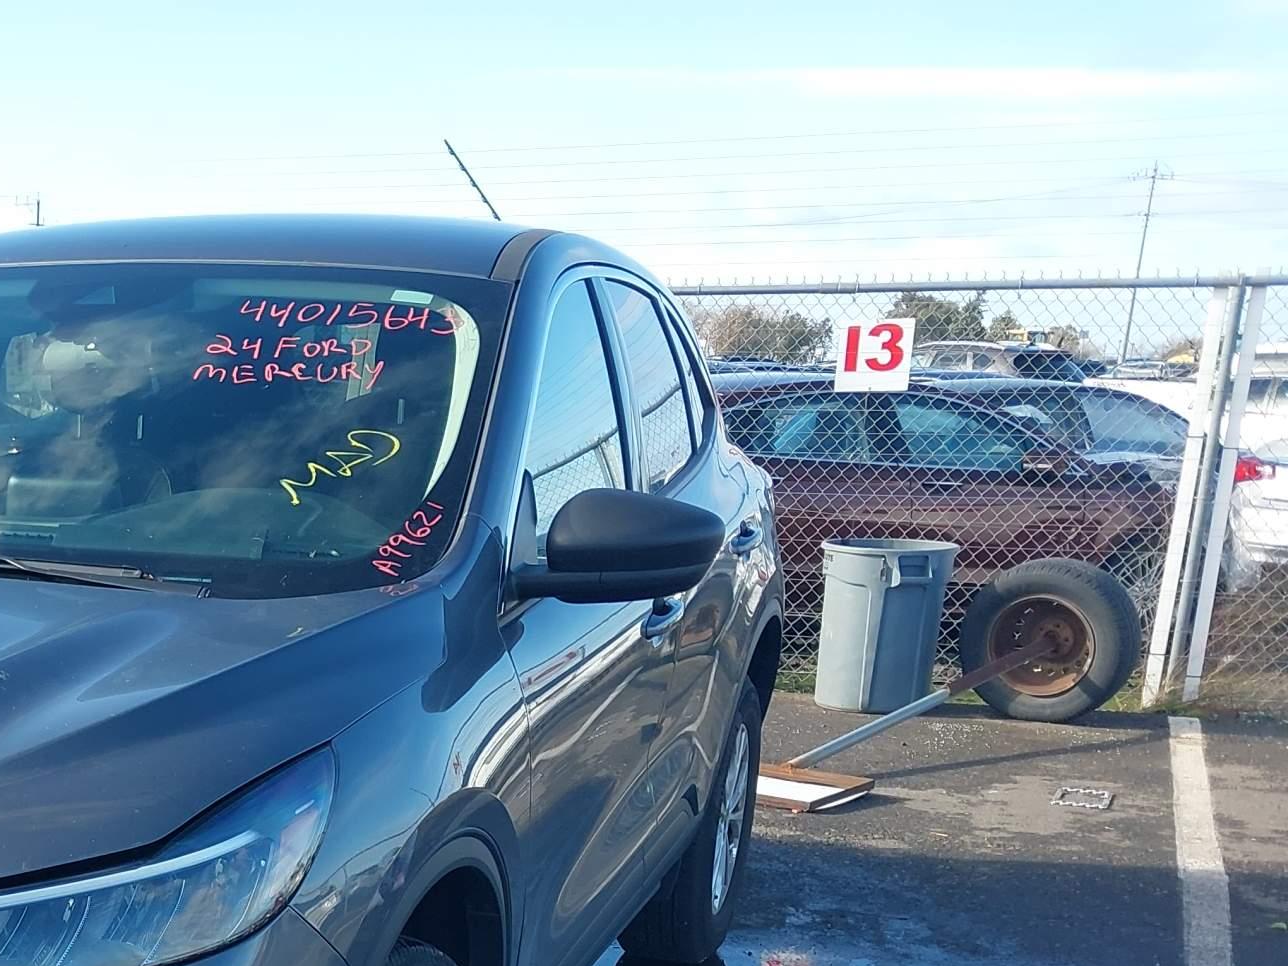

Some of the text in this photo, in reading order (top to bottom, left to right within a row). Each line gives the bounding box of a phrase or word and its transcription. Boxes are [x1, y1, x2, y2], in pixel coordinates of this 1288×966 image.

[240, 299, 466, 335] 44015643
[206, 335, 372, 359] 24 FORD
[844, 323, 904, 372] 13
[192, 361, 385, 390] MERCURY
[371, 501, 445, 577] A99621
